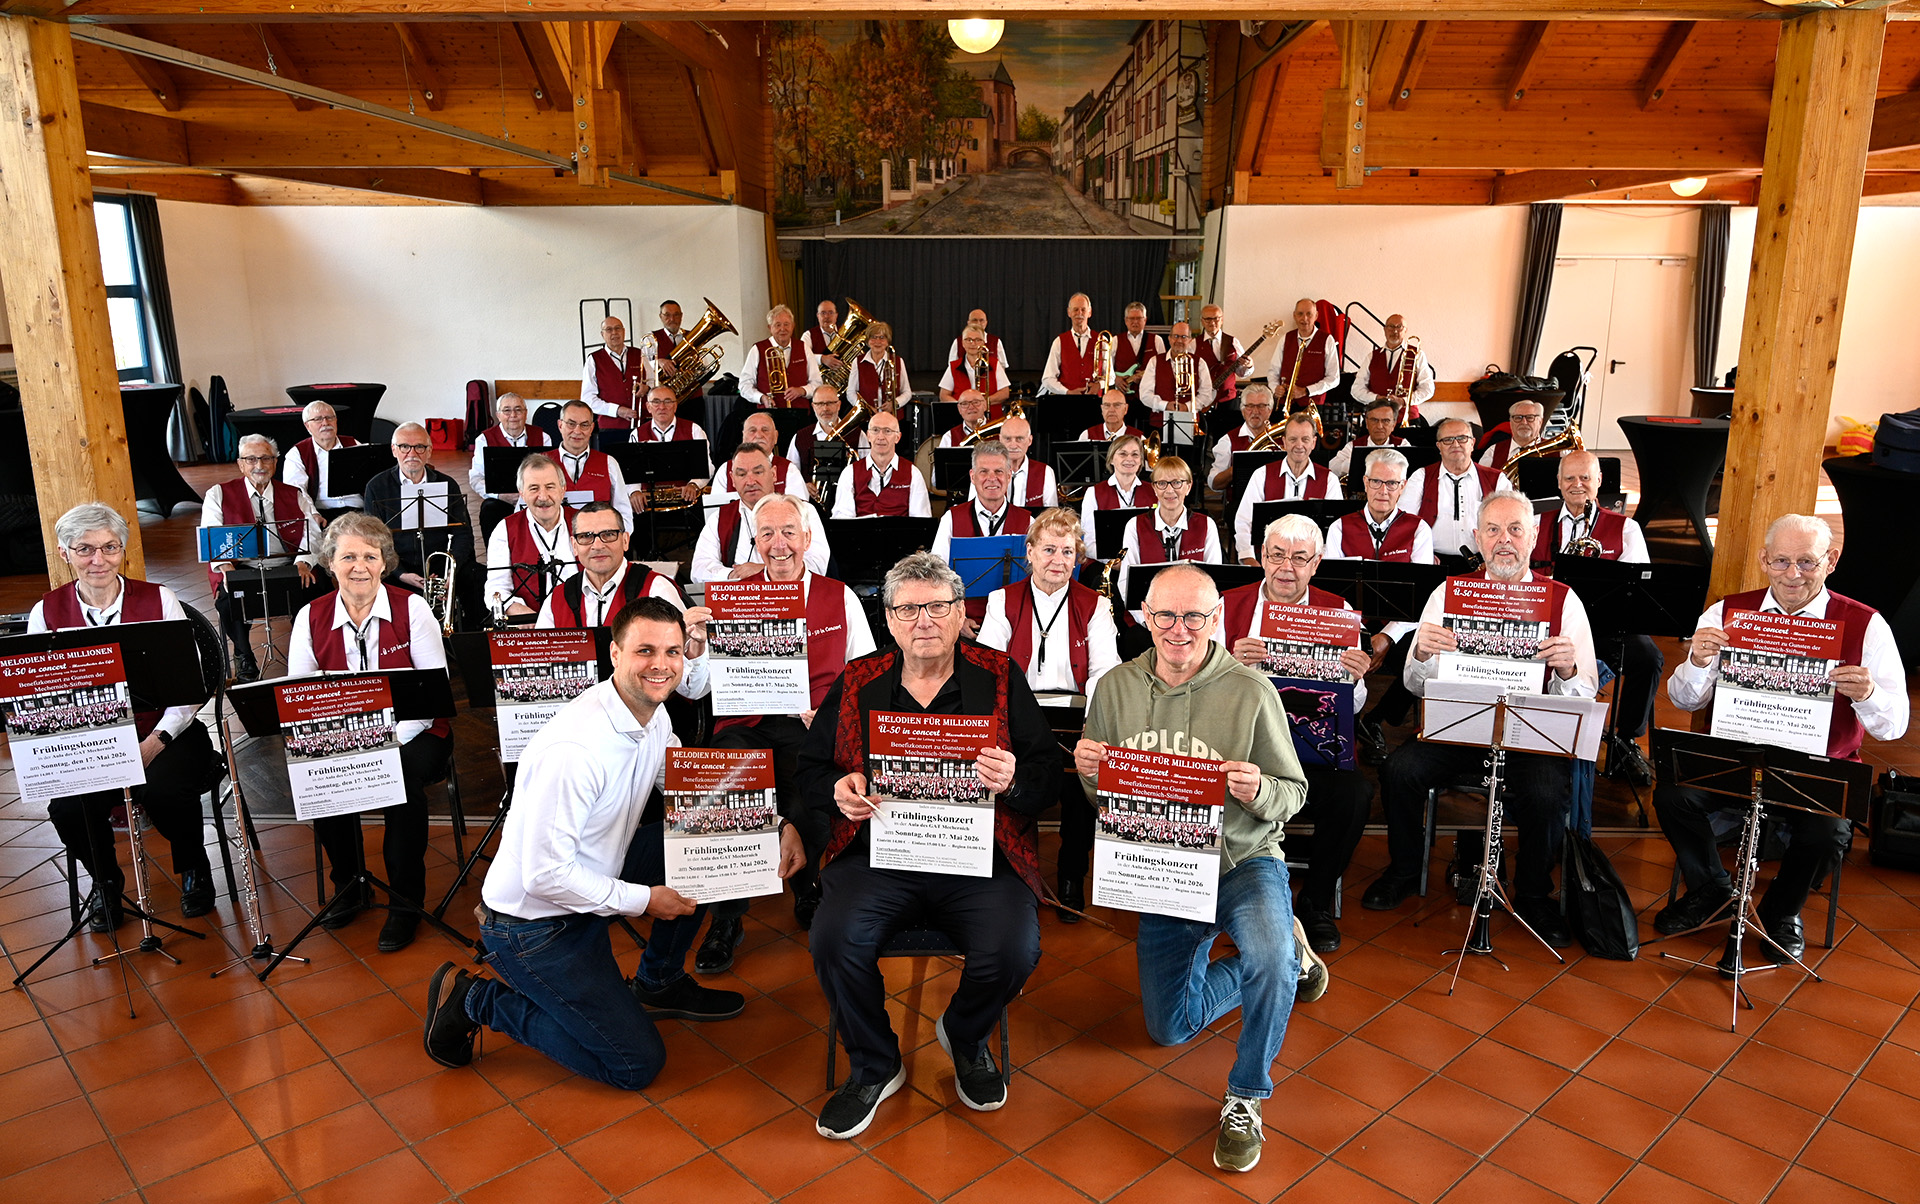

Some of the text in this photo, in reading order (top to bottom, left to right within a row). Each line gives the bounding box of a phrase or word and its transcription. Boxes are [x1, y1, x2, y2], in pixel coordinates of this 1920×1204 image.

[746, 583, 760, 591] FÜR
[1453, 580, 1546, 593] MELODIEN FÜR MILLIONEN
[711, 592, 729, 600] Ü-50
[1269, 604, 1355, 619] MELODIEN FÜR MILLIONEN
[1732, 612, 1836, 630] MELODIEN FÜR MILLIONEN
[0, 647, 112, 667] MELODIEN FÜR MILLIONEN
[3, 667, 26, 676] Ü-50
[38, 663, 67, 672] concert
[1456, 664, 1526, 677] Frühlingskonzert
[282, 684, 322, 694] MELODIEN
[341, 679, 382, 687] MILLIONEN
[284, 694, 305, 703] Ü-50
[315, 690, 341, 699] concert
[1733, 698, 1811, 714] Frühlingskonzert
[877, 715, 989, 727] MELODIEN FÜR MILLIONEN
[878, 723, 901, 734] Ü-50
[33, 737, 117, 755] Frühlingskonzert
[672, 751, 709, 759] MELODIEN
[711, 751, 725, 759] FÜR
[1107, 750, 1218, 771] MELODIEN FÜR MILLIONEN
[308, 759, 383, 776] Frühlingskonzert
[673, 759, 692, 768] Ü-50
[1107, 757, 1169, 777] Ü-50 in concert
[891, 811, 973, 824] Frühlingskonzert
[684, 844, 761, 855] Frühlingskonzert
[1115, 851, 1198, 870] Frühlingskonzert
